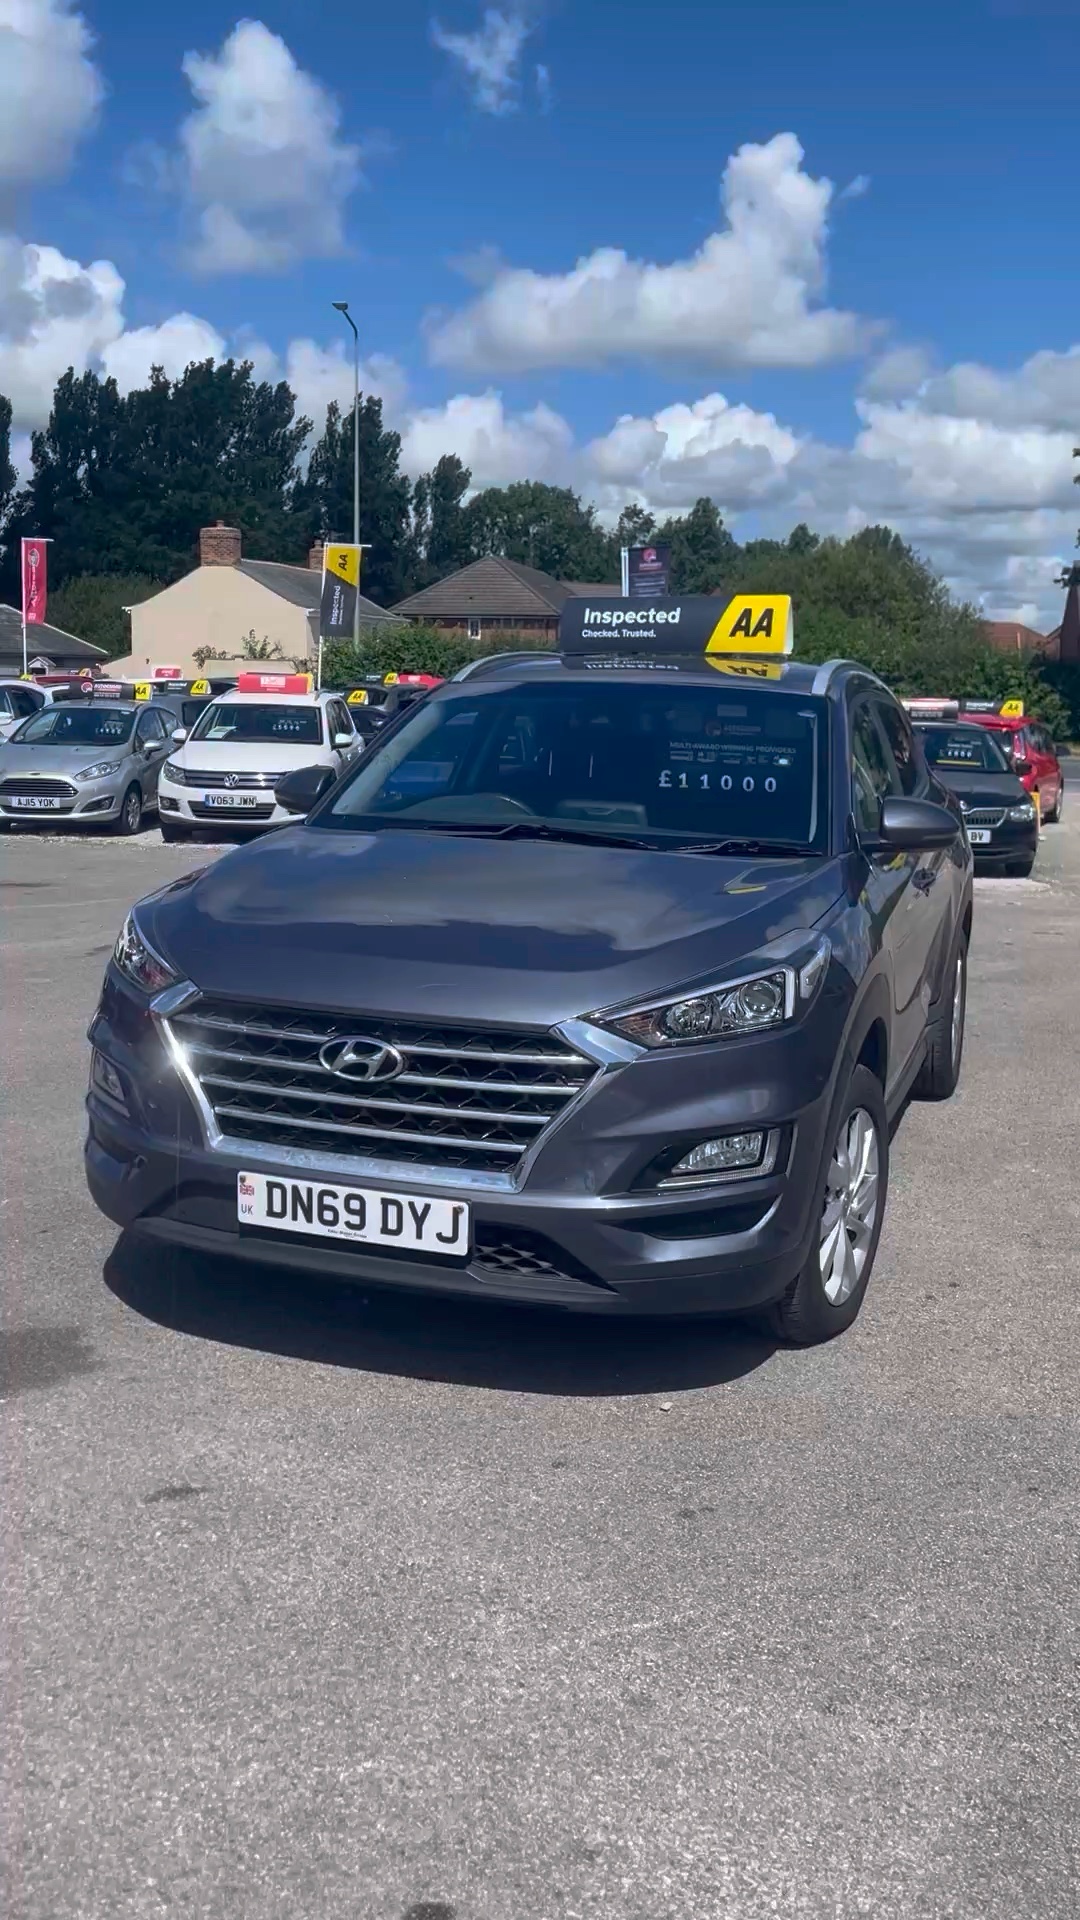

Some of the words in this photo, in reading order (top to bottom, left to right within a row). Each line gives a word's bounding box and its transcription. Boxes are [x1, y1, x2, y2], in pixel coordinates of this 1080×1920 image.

[338, 554, 348, 571] AA
[330, 585, 341, 625] Inspected
[583, 607, 681, 626] Inspected
[729, 608, 774, 638] AA
[581, 629, 620, 639] Checked.
[621, 629, 656, 639] Trusted.
[135, 686, 147, 695] AA
[16, 797, 36, 807] AJ15
[37, 798, 55, 808] YOK
[208, 795, 235, 806] VO63
[240, 1203, 254, 1216] UK
[266, 1180, 367, 1231] DN69
[380, 1197, 465, 1244] DYJ
